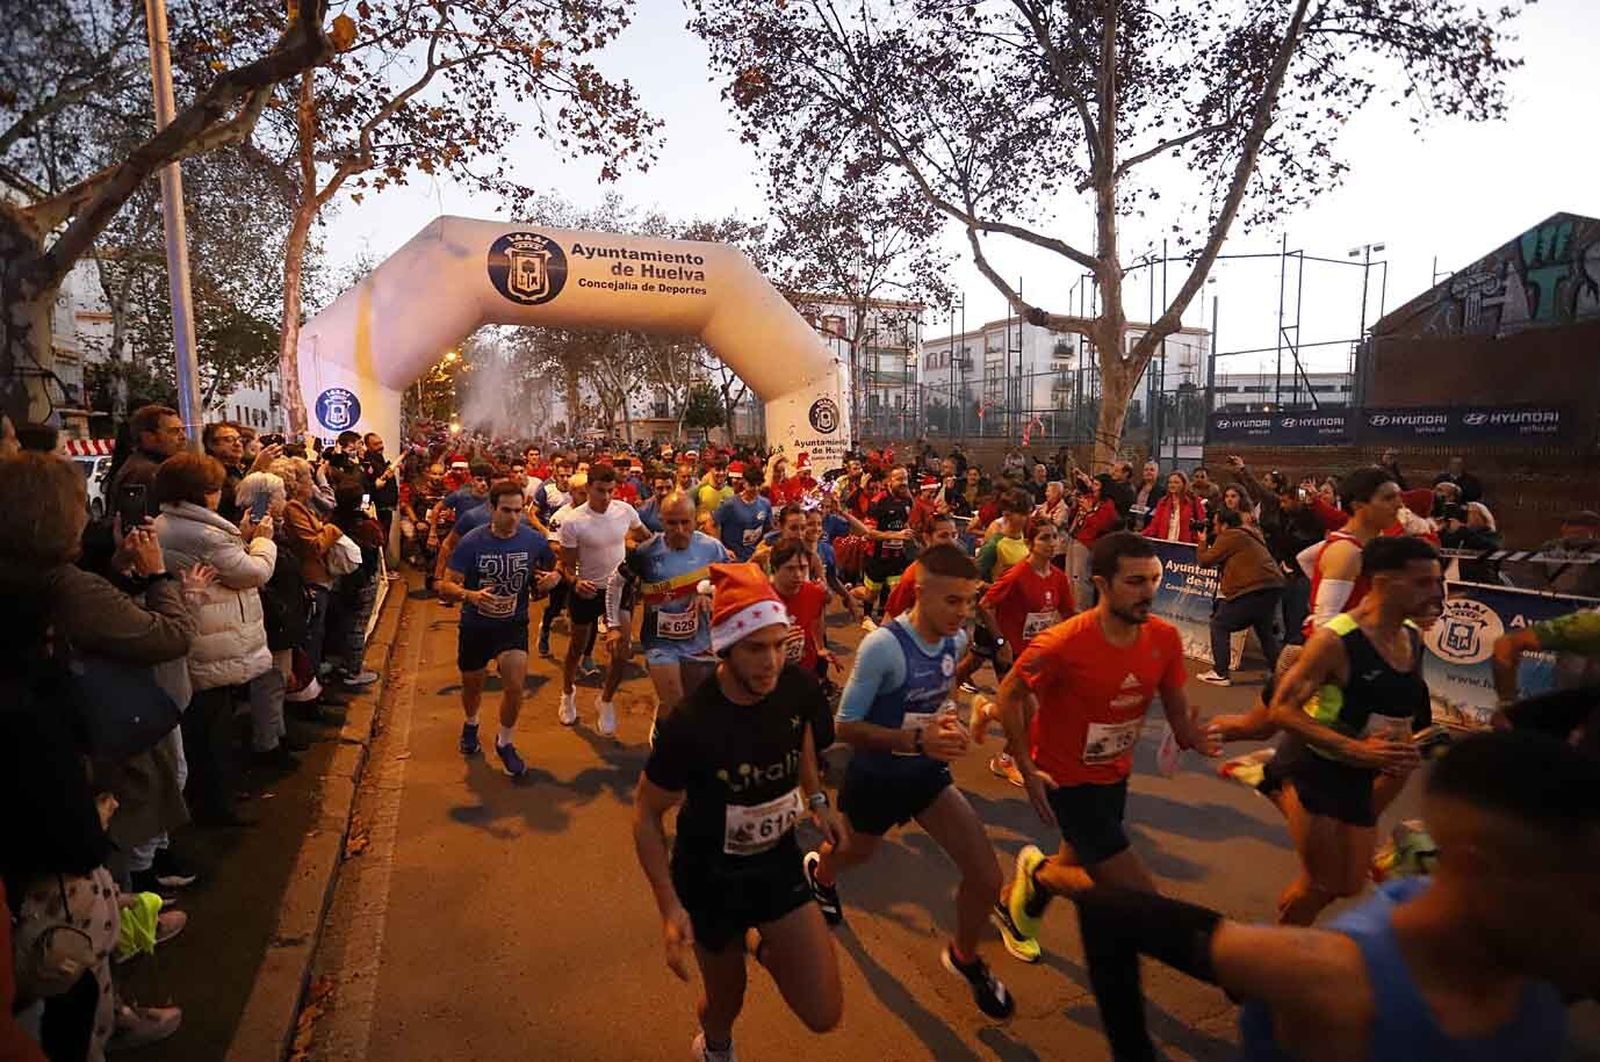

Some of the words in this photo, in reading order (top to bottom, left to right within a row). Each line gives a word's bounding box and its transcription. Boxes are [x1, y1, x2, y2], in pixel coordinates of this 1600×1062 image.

[571, 243, 704, 265] Ayuntamiento
[611, 262, 634, 276] de
[641, 263, 705, 281] Huelva
[641, 282, 656, 291] de
[658, 284, 707, 295] Deportes
[1231, 419, 1271, 428] HYUNDAI
[1299, 417, 1345, 426] HYUNDAI
[1391, 415, 1447, 425] HYUNDAI
[1490, 412, 1560, 424] HYUNDAI
[1165, 560, 1217, 576] Ayuntam
[1186, 575, 1202, 586] de
[673, 620, 695, 632] 629
